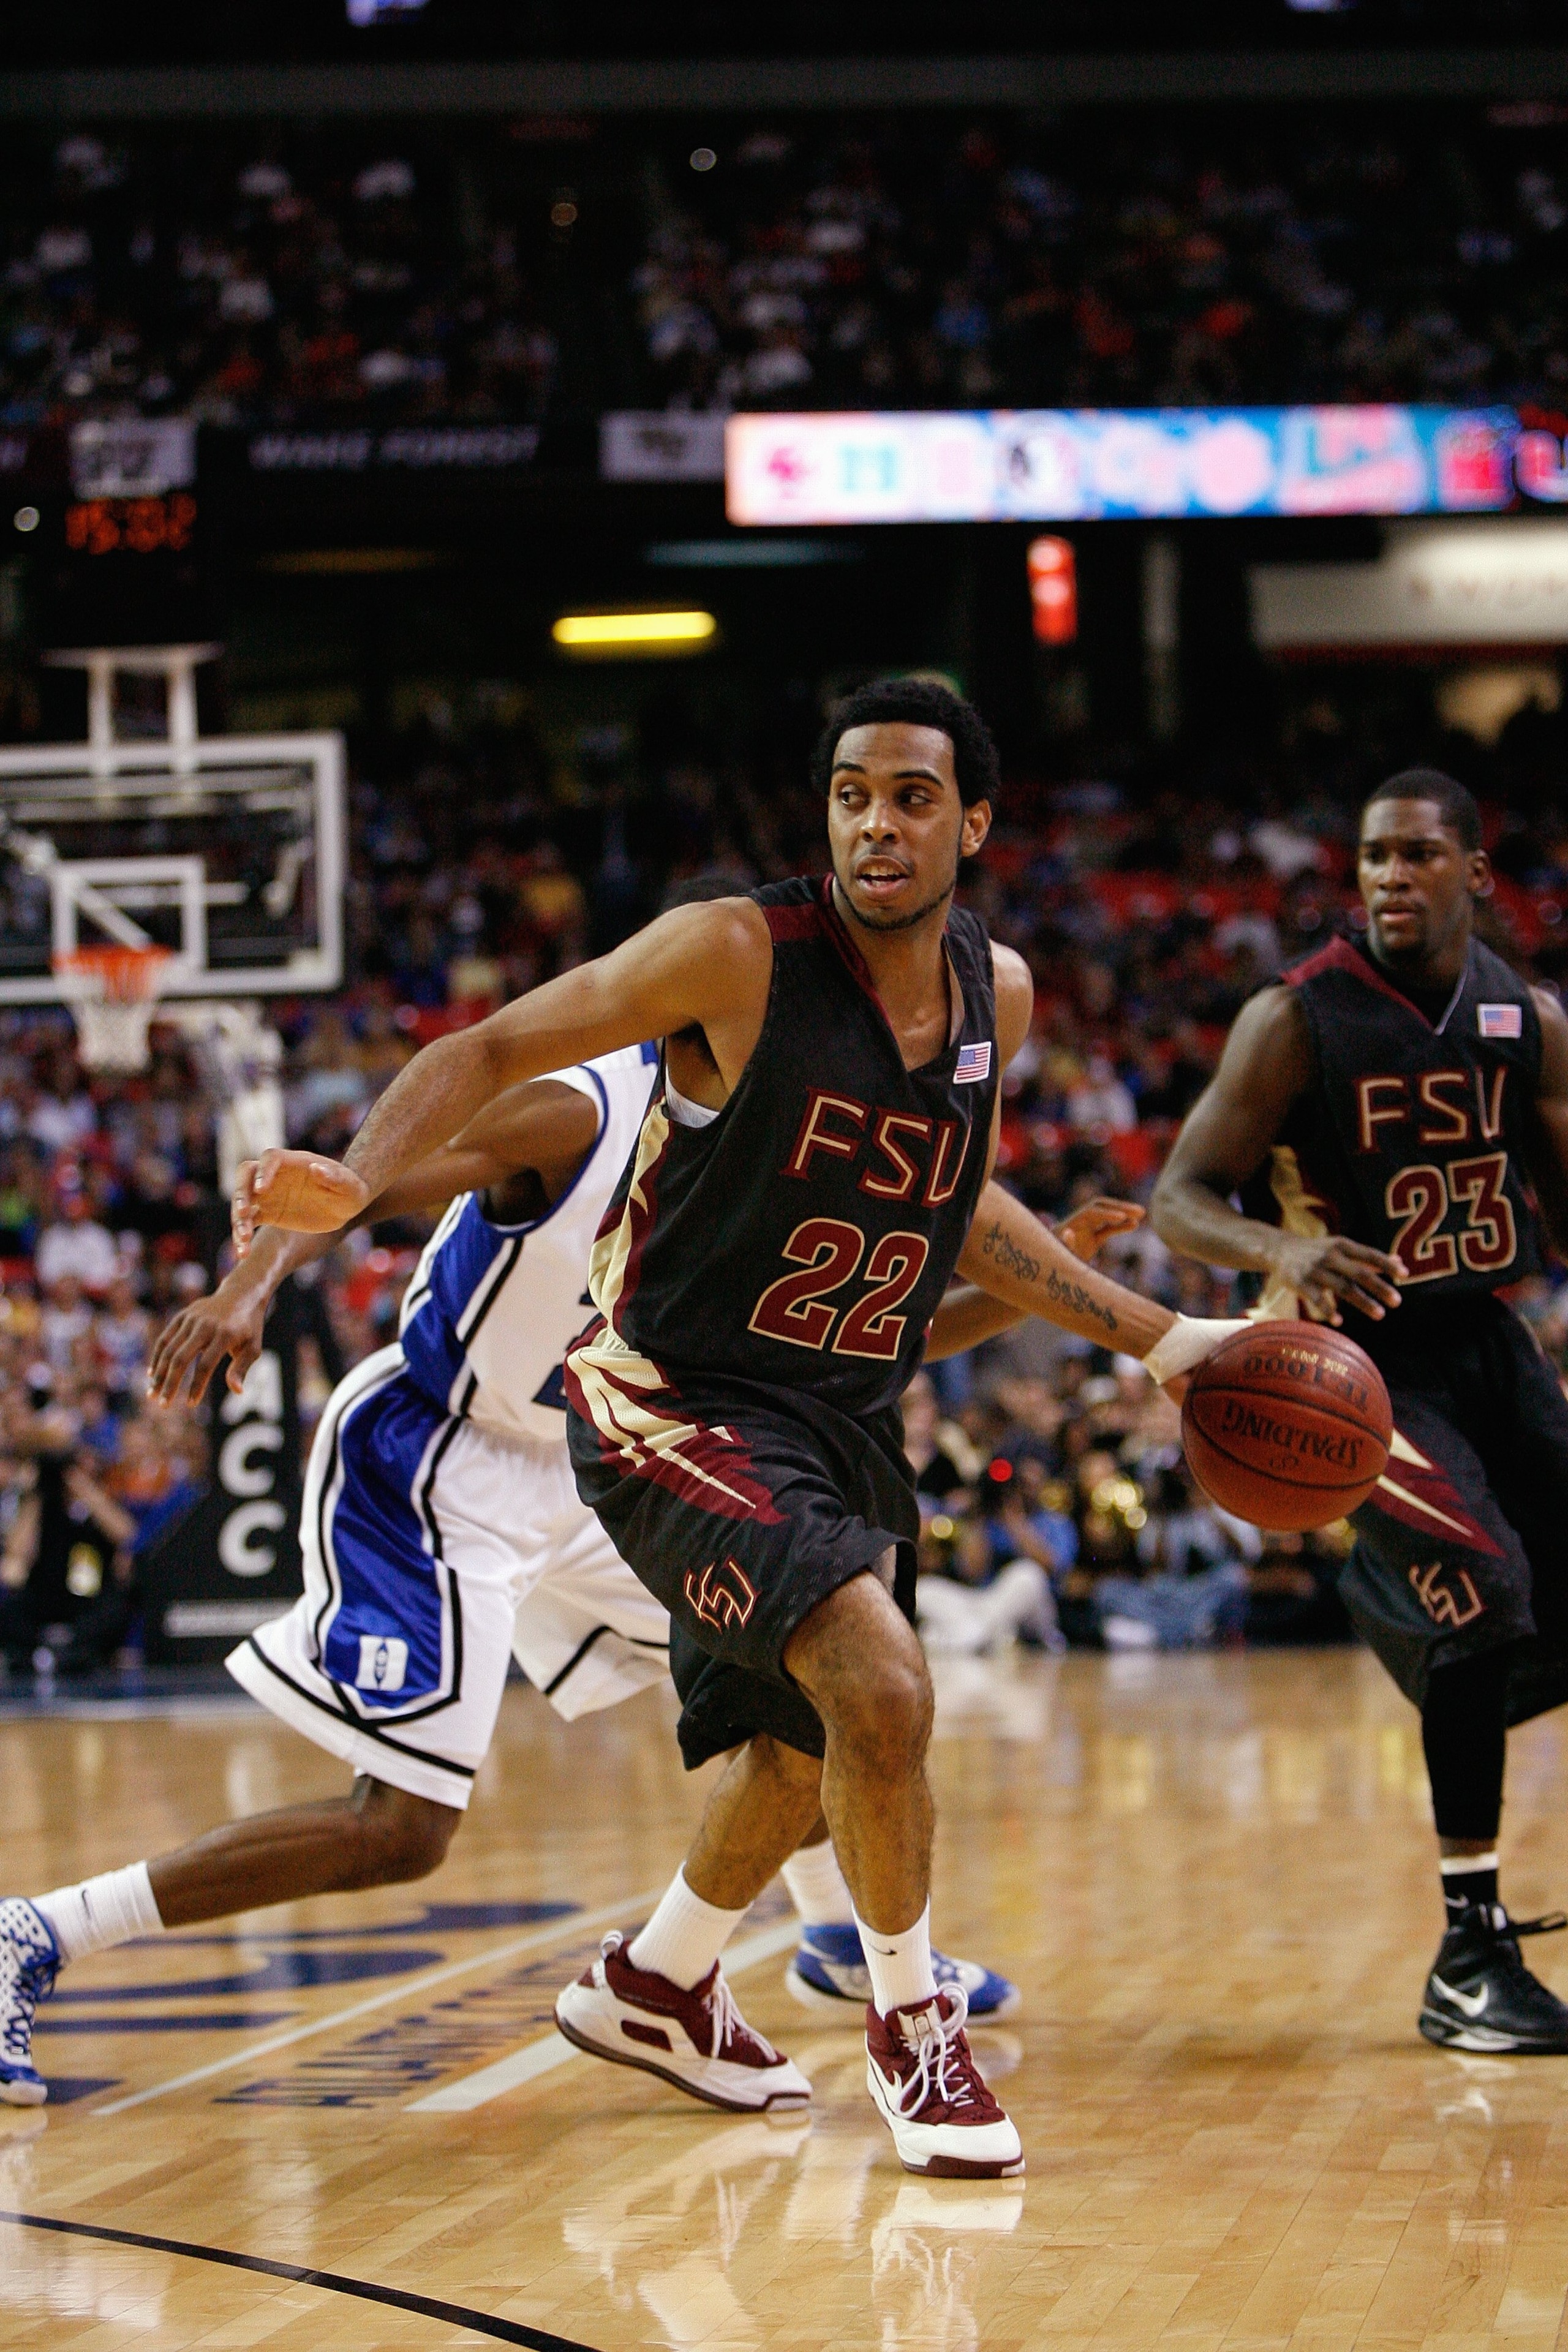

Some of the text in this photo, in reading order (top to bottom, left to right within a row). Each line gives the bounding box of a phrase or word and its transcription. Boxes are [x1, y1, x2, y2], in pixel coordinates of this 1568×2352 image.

[779, 1085, 974, 1208] FSU
[1352, 1065, 1508, 1154] FSU
[1385, 1151, 1517, 1286] 23
[747, 1218, 929, 1360] 22
[218, 1351, 287, 1578] ACC
[1221, 1396, 1363, 1469] SPALDING
